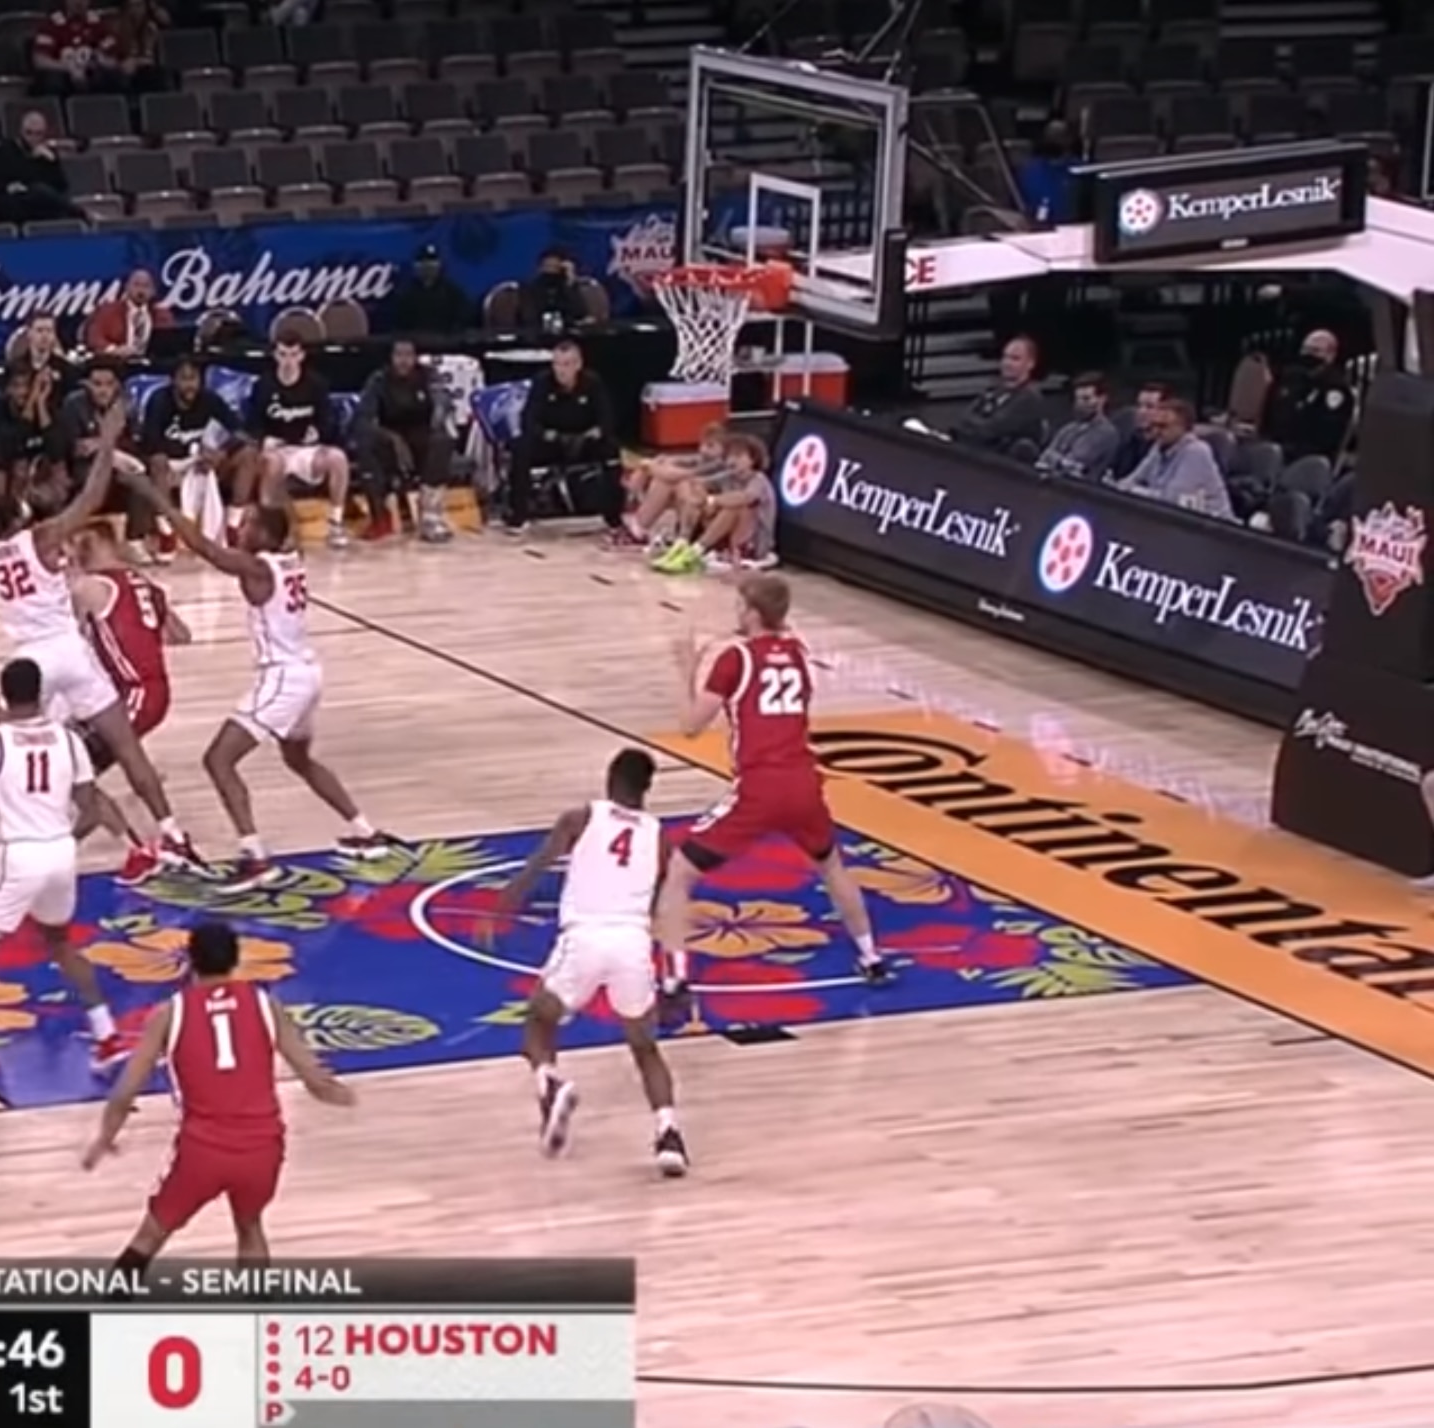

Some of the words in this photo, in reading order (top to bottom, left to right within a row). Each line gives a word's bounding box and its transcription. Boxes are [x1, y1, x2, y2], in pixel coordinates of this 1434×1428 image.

[1168, 176, 1342, 220] KemperLesnik
[621, 247, 675, 263] MAU
[156, 247, 394, 310] Bahama
[828, 458, 1011, 558] KemperLesnik
[1359, 534, 1416, 567] MAUI
[1093, 541, 1316, 651] KemperLesnik
[759, 667, 803, 715] 22
[27, 750, 50, 793] 11
[607, 827, 633, 867] 4
[211, 1012, 237, 1070] 1
